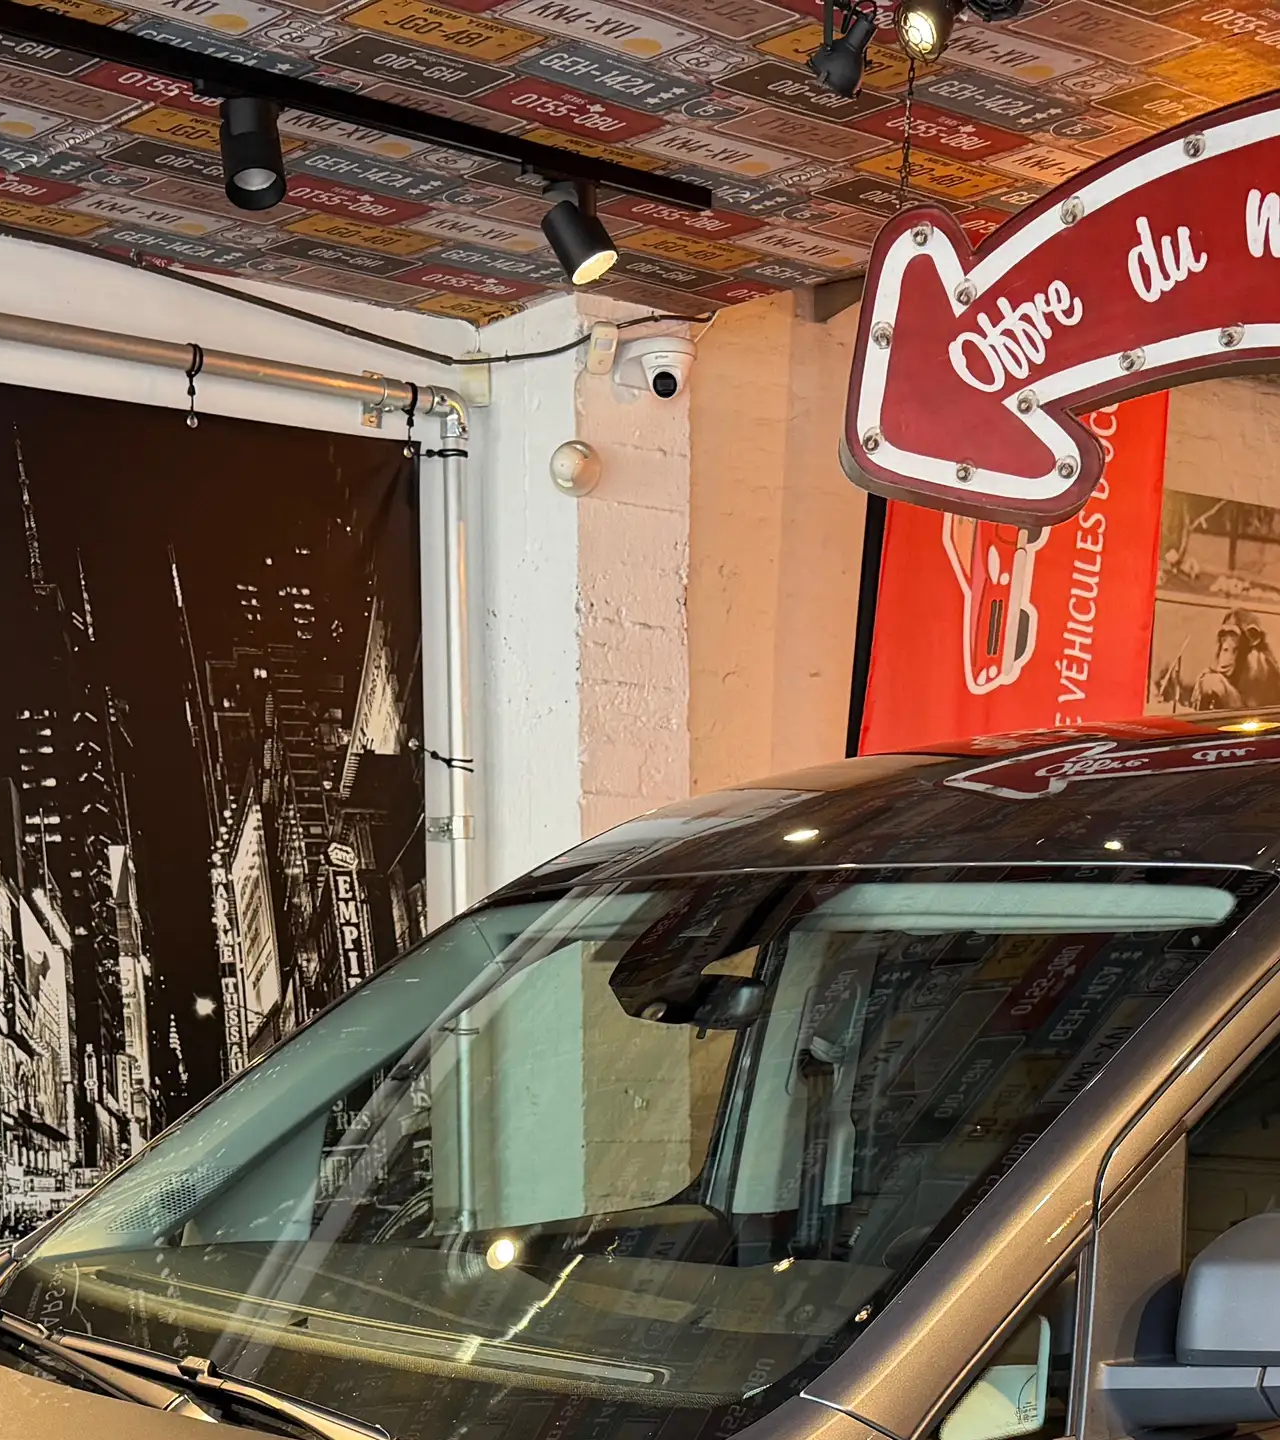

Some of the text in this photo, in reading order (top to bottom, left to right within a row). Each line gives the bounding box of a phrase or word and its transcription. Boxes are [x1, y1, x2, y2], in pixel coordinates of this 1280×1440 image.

[1127, 216, 1208, 303] du
[1057, 510, 1108, 703] VÉHICULES
[335, 875, 362, 989] EMPI
